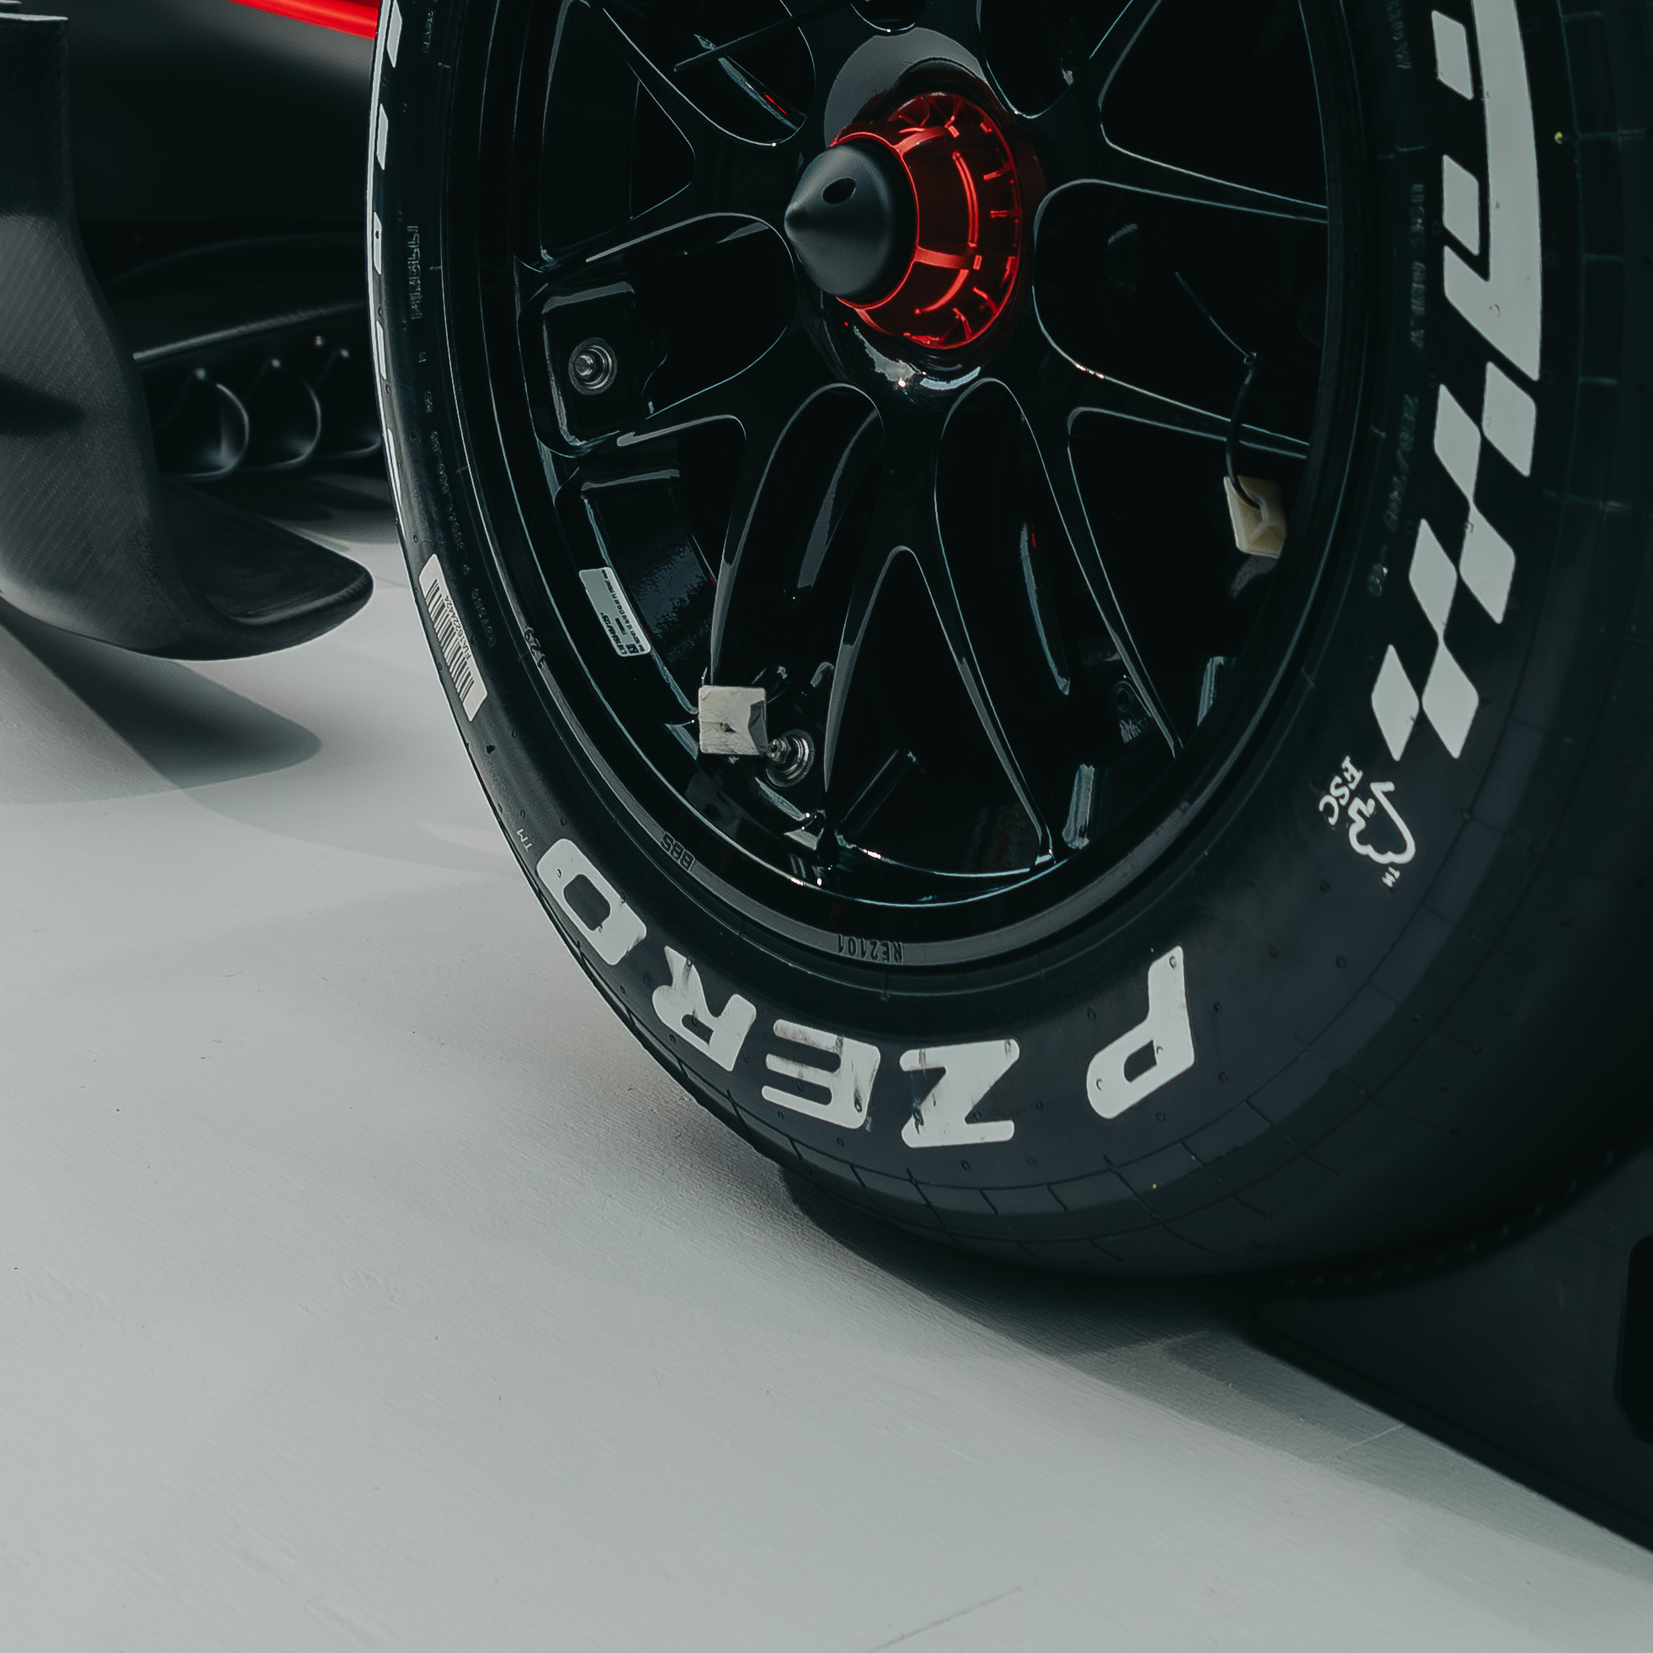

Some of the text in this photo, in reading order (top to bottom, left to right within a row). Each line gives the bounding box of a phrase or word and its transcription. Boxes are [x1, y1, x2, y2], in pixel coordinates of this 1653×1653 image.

[1318, 755, 1364, 826] FSC
[660, 831, 697, 871] BBS
[837, 933, 905, 964] RE2101
[536, 838, 1196, 1149] P ZERO
